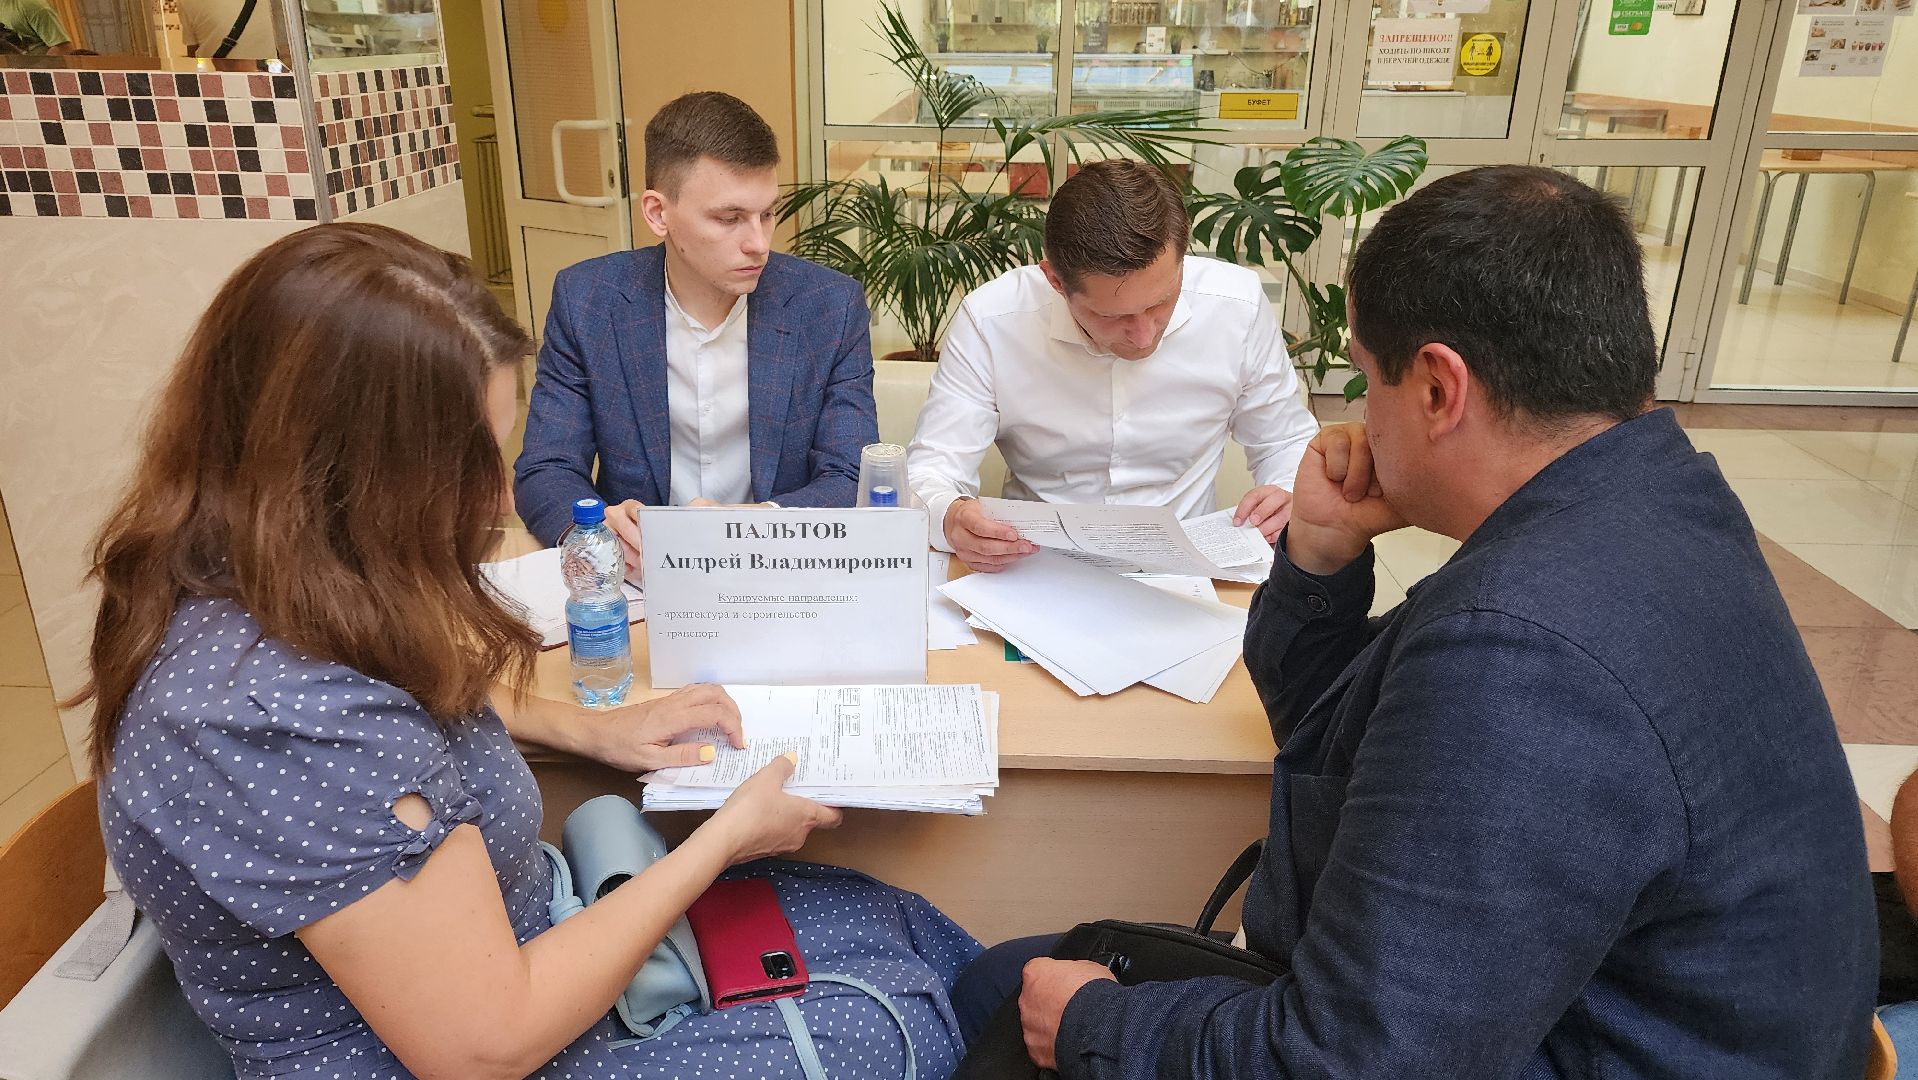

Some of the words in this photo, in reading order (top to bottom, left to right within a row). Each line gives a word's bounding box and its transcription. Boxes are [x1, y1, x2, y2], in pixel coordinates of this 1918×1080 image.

[1379, 34, 1453, 43] ЗАПРЕЩЕНО!!!
[725, 522, 847, 540] ПАЛЬТОВ
[660, 553, 742, 574] Андрей
[748, 553, 913, 574] Владимирович
[717, 592, 785, 604] Курируемые
[664, 610, 730, 620] архитектура
[733, 610, 739, 619] и
[742, 609, 818, 620] строительство
[666, 630, 720, 640] транспорт
